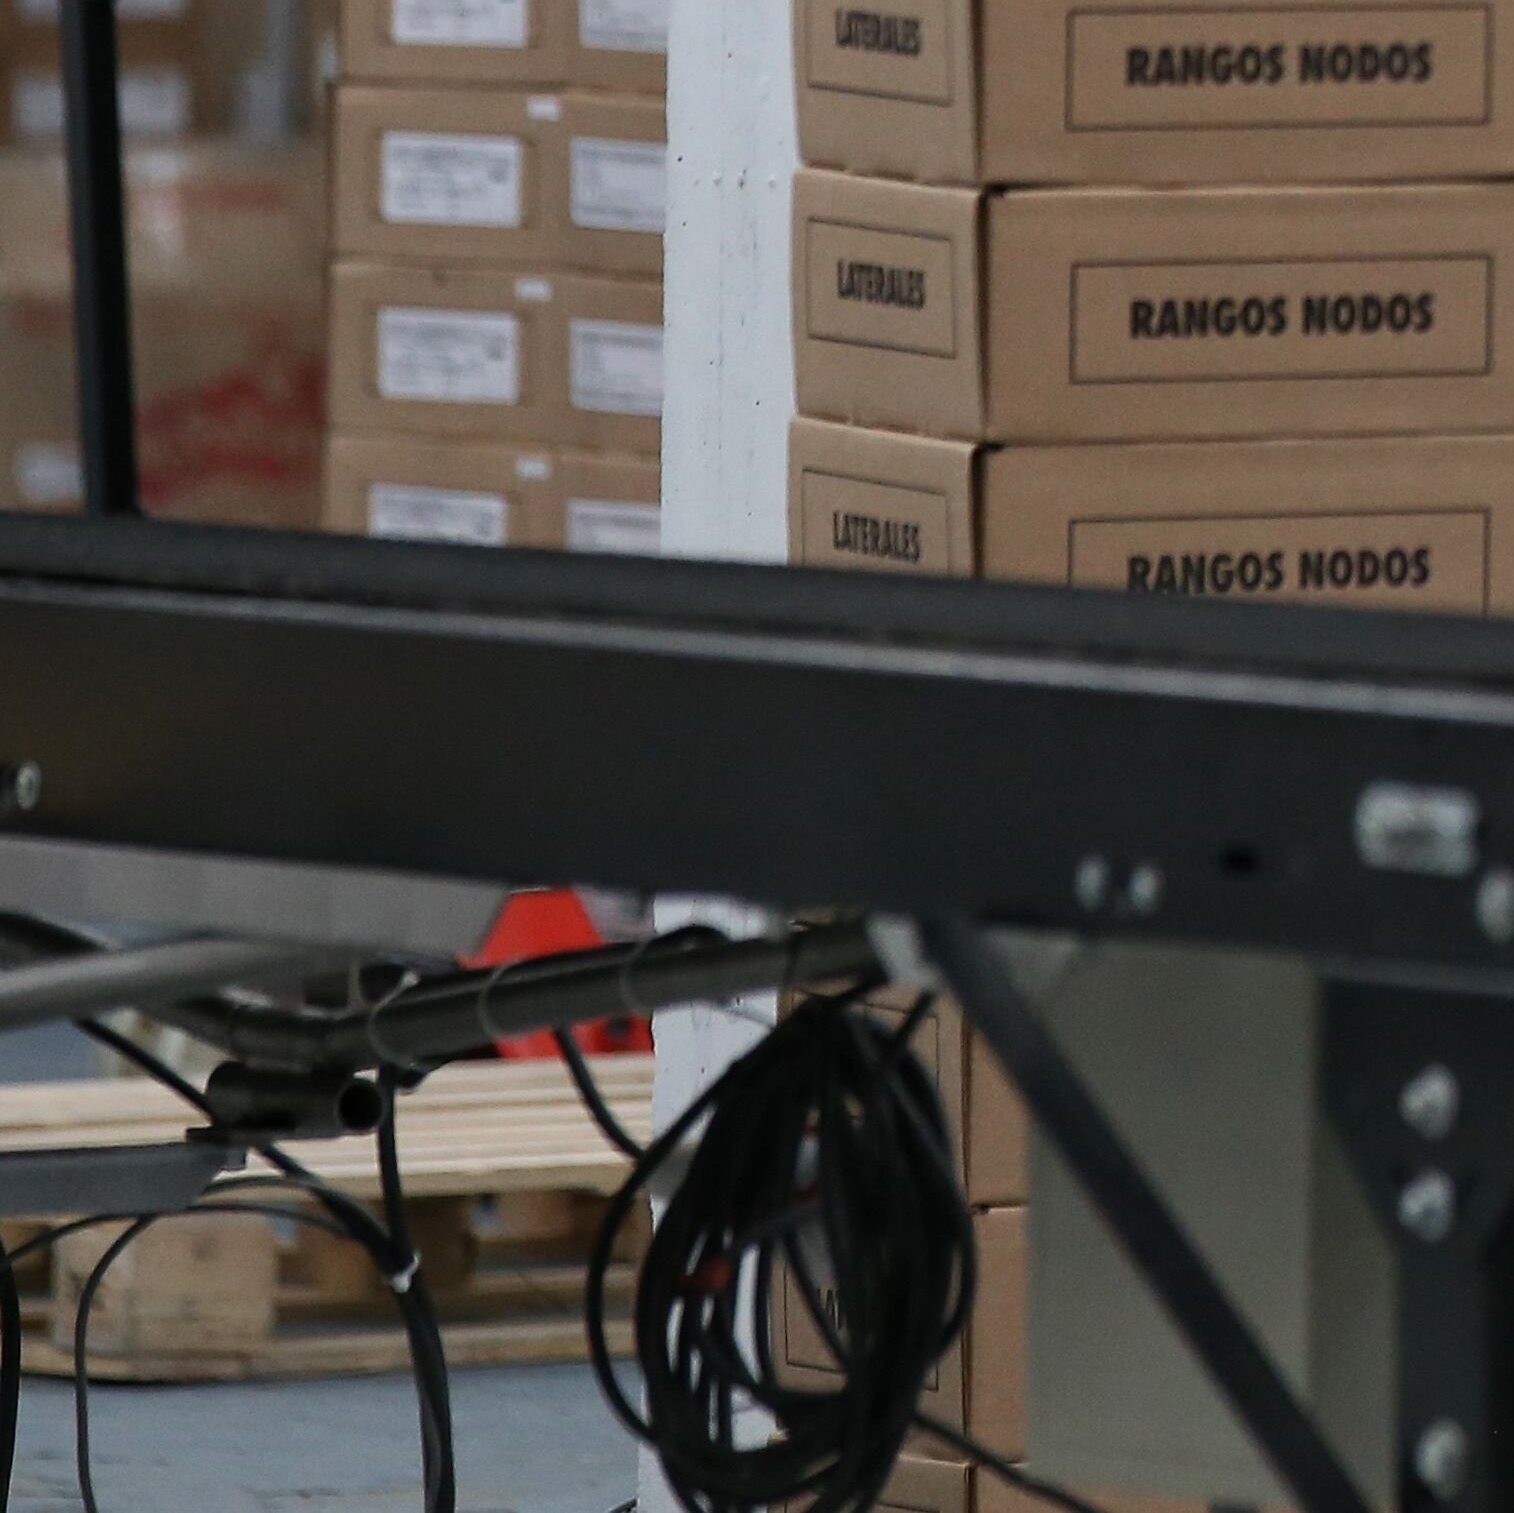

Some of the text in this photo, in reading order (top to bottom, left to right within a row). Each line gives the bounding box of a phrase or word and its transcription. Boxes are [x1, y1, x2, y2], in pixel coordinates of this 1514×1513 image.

[835, 9, 922, 57] LATERALES
[1125, 41, 1433, 87] RANGOS NODOS
[837, 260, 926, 310] LATERALES
[1129, 292, 1435, 340] RANGOS NODOS
[832, 512, 922, 564] LATERALES
[1127, 547, 1430, 594] RANGOS NODOS
